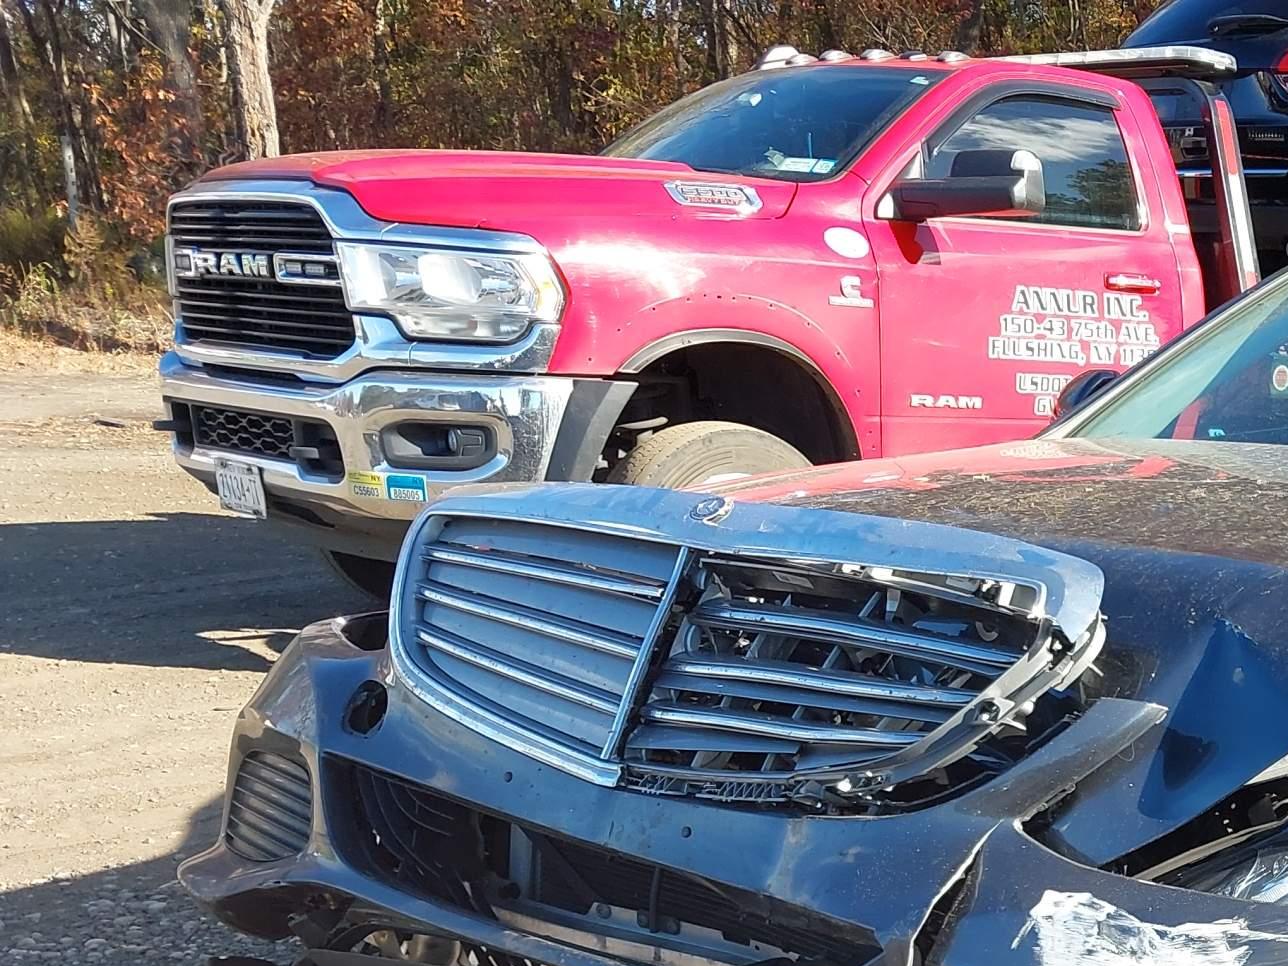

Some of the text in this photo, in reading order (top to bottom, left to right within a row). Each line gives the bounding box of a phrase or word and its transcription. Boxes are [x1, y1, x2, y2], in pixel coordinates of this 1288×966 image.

[193, 251, 270, 277] RAM
[1014, 288, 1147, 319] ANNUR INC.
[1002, 316, 1158, 343] 150-43 75th AVE.
[991, 338, 1085, 361] FLUSHING,
[1093, 345, 1114, 362] NY
[910, 394, 983, 409] RAM
